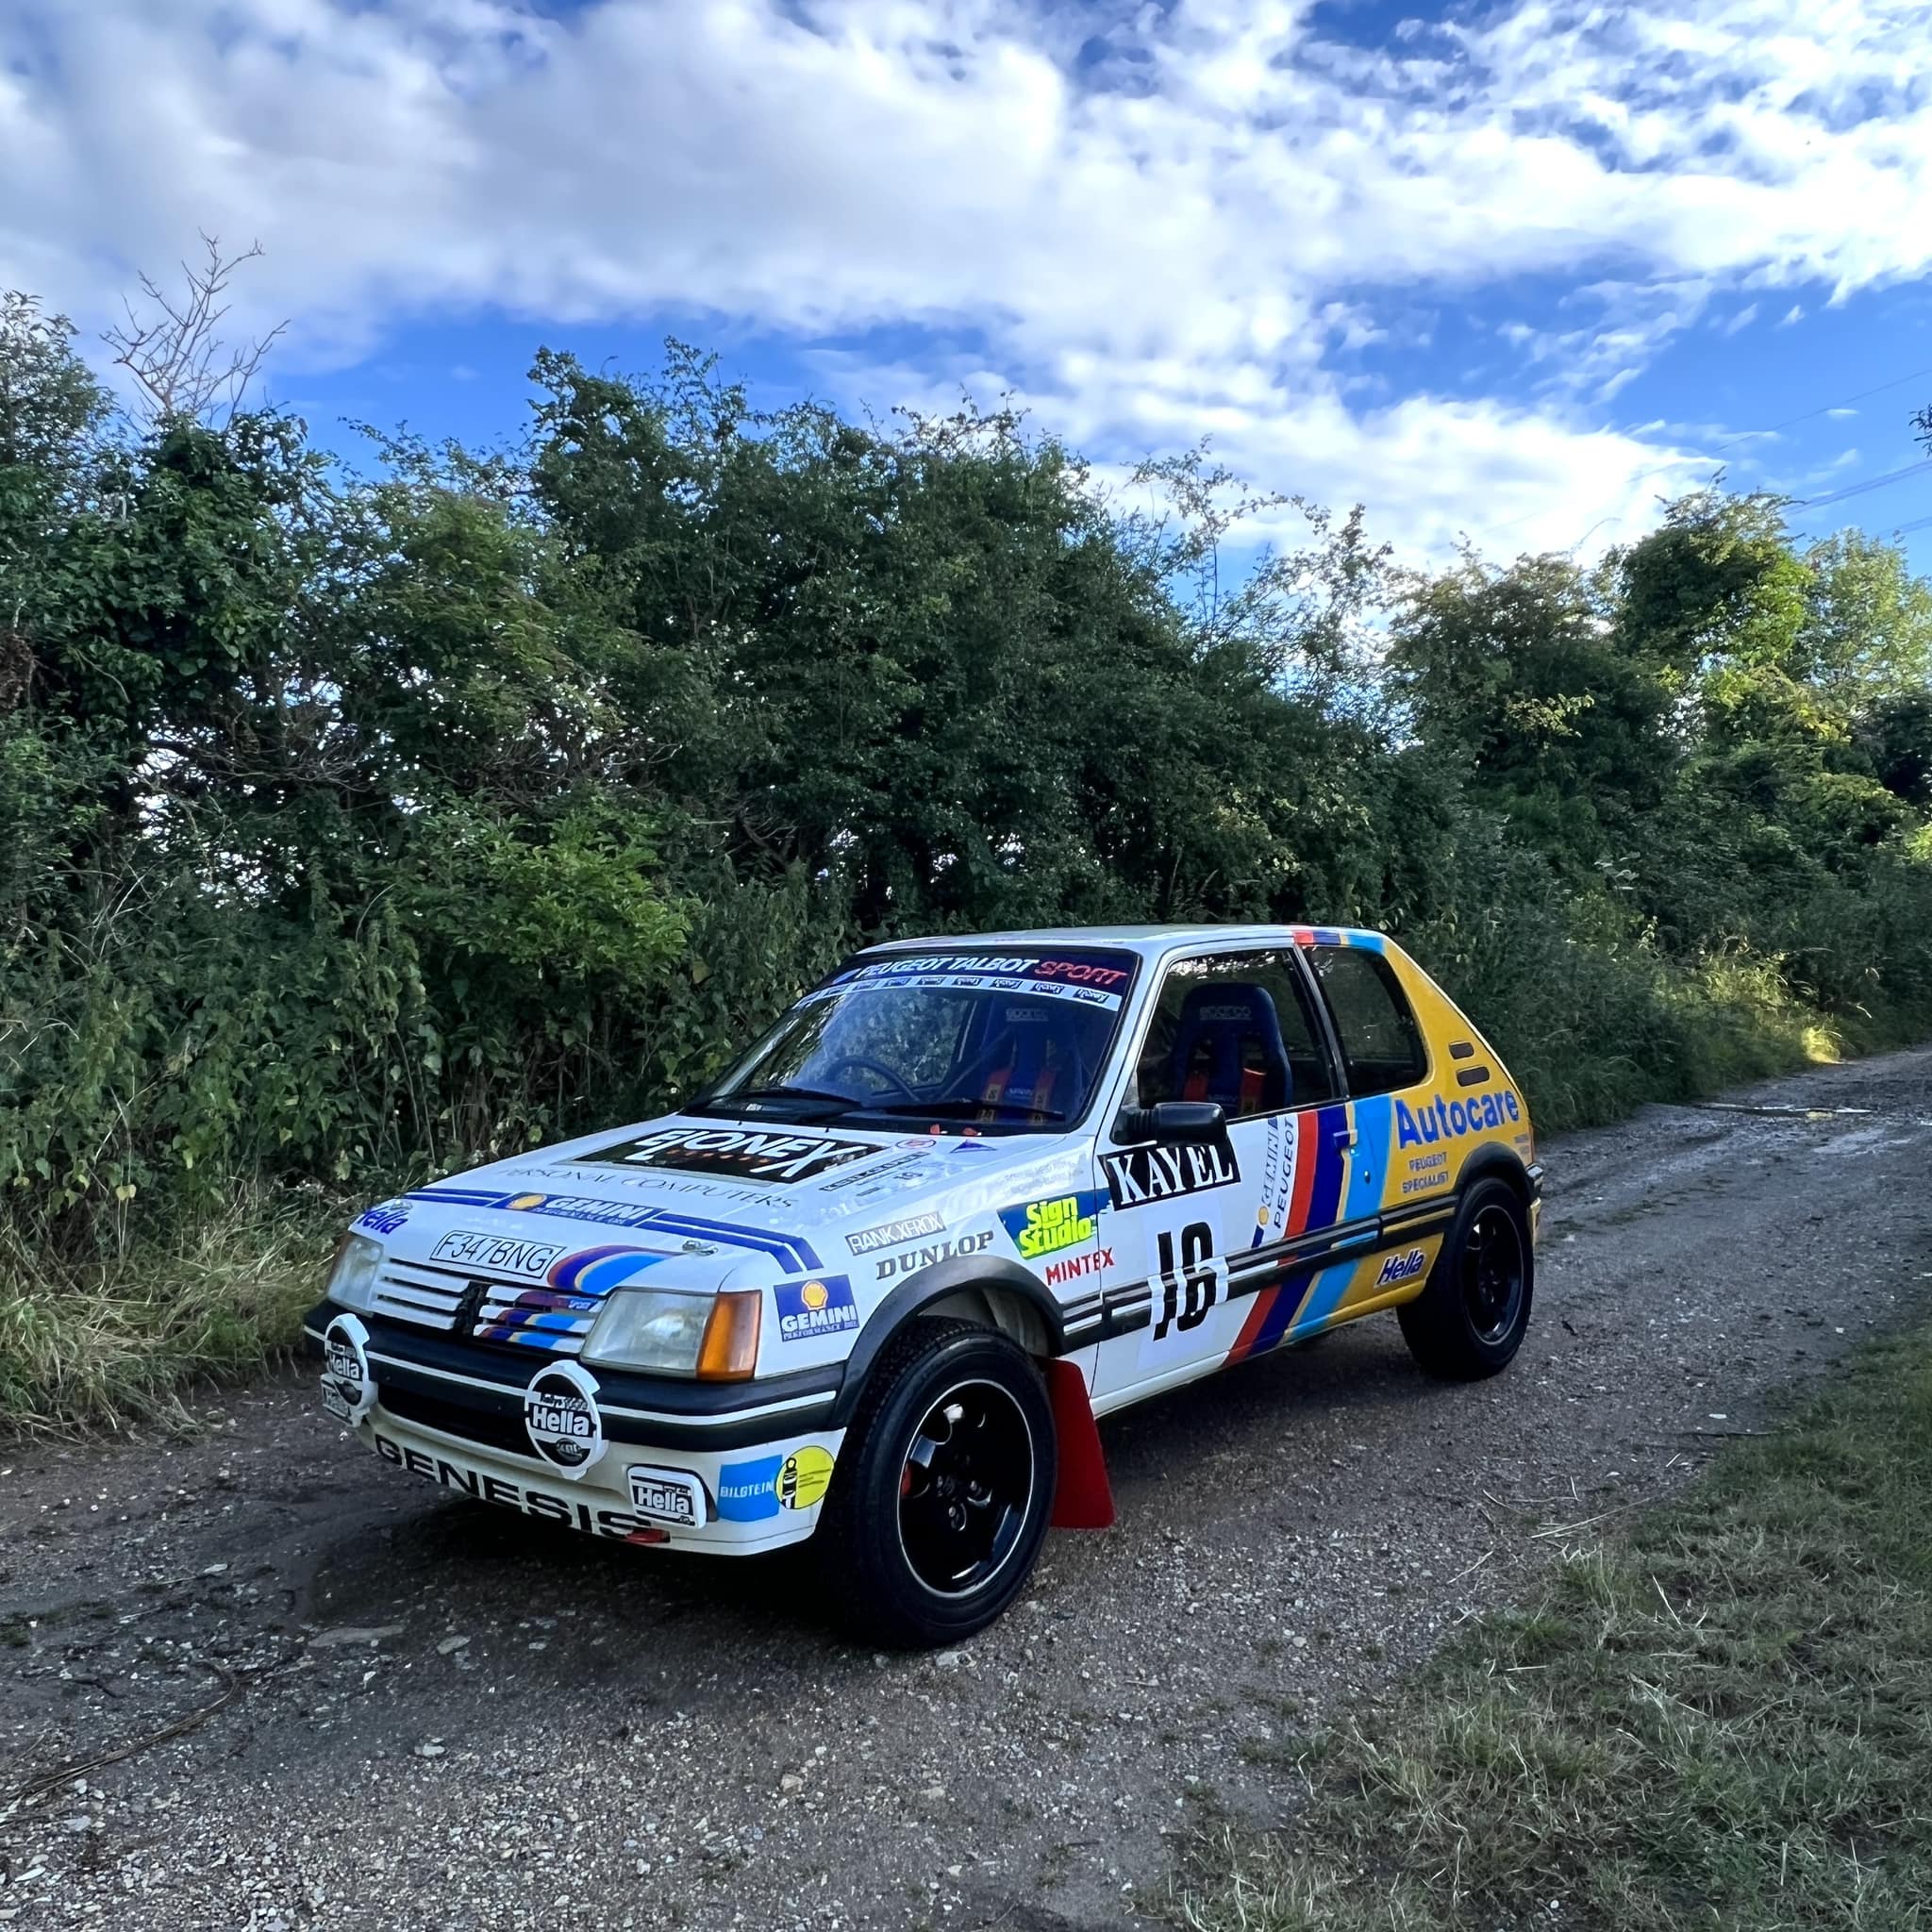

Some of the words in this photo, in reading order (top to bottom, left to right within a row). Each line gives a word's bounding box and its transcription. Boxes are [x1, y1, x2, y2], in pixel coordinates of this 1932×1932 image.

[855, 957, 947, 978] PEUGEOT
[947, 957, 1040, 974] TALBOT
[1034, 961, 1127, 986] SPORT
[1394, 1091, 1519, 1149] Autocare
[1107, 1144, 1234, 1206] KAYEL
[1274, 1117, 1294, 1228] PEUGEOT
[1409, 1152, 1448, 1172] PEUGEOT
[546, 1196, 654, 1221] GEMINI
[621, 1175, 799, 1208] COMPUTERS
[1025, 1196, 1078, 1229] Sign
[848, 1225, 897, 1254] RANK
[895, 1213, 943, 1241] XEROX
[1019, 1216, 1091, 1257] Studio
[436, 1233, 554, 1272] F347BNG
[875, 1230, 994, 1280] DUNLOP
[1045, 1247, 1114, 1285] MINTEX
[1374, 1249, 1425, 1285] Hella
[781, 1305, 858, 1332] GEMINI
[532, 1405, 590, 1436] Hella
[375, 1433, 652, 1542] GENESIS
[637, 1487, 690, 1514] Hella
[720, 1479, 776, 1499] BILSTEIN
